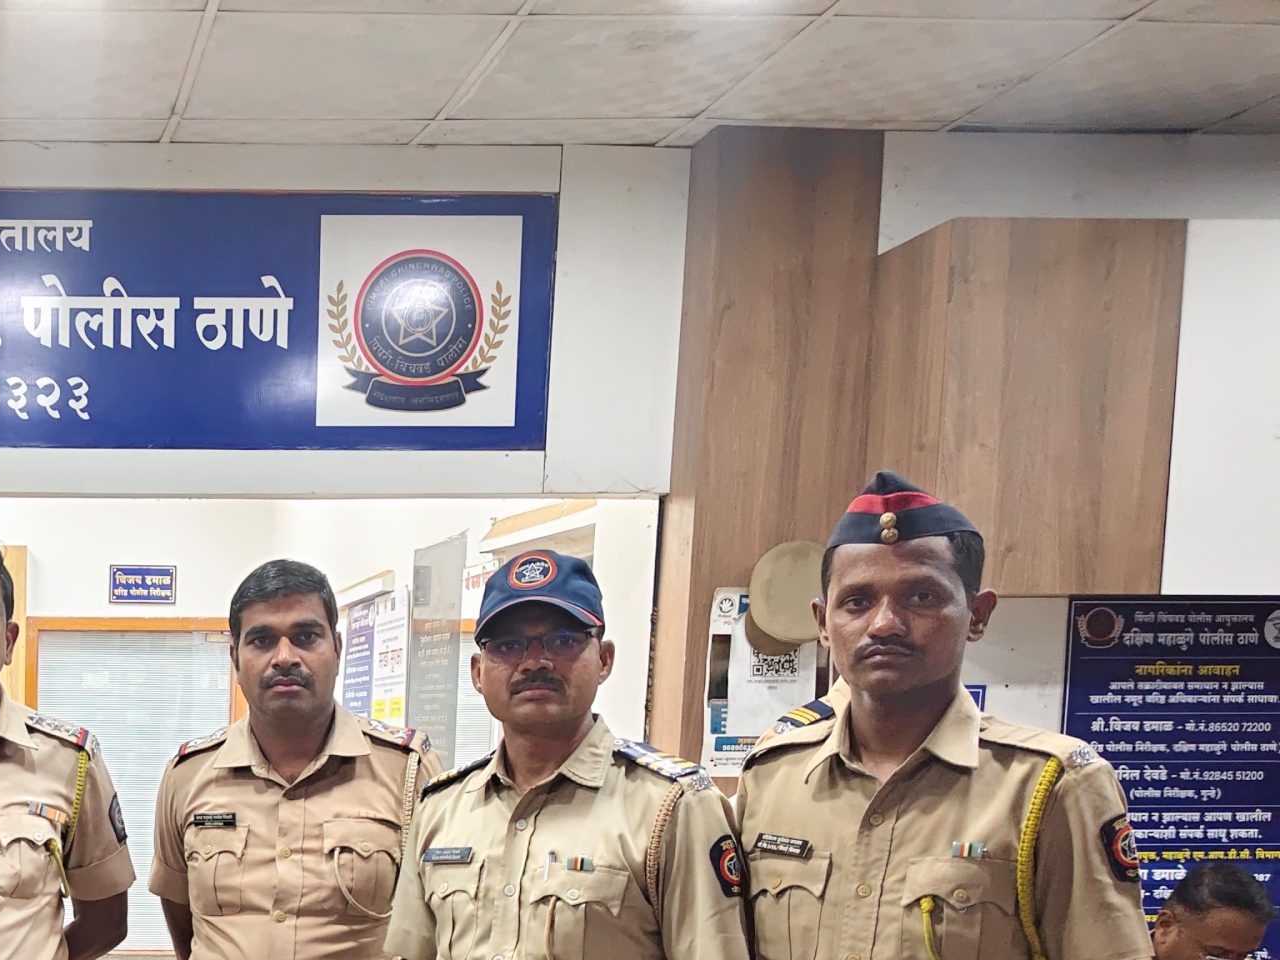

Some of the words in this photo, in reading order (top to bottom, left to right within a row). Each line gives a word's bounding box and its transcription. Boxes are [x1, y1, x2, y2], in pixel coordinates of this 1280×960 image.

[21, 273, 181, 351] पोलीस
[193, 274, 294, 351] ठाणे
[1122, 627, 1154, 646] दक्षिण
[1156, 627, 1194, 651] महाळुंगे
[1199, 627, 1234, 645] पोलीस
[1237, 627, 1260, 645] ठाणे
[1134, 660, 1193, 676] नागरिकांना
[1198, 665, 1241, 677] आवाहन
[1221, 681, 1228, 690] न
[1089, 692, 1122, 704] खालील
[1241, 722, 1271, 732] 72200
[1105, 741, 1134, 752] पोलीस
[1230, 740, 1258, 752] पोलीस
[1143, 765, 1168, 782] देवडे
[1235, 770, 1264, 780] 51200
[1151, 812, 1160, 822] न
[1161, 812, 1201, 824] झाल्यास
[1203, 811, 1233, 822] आपण
[1234, 808, 1272, 822] खालील
[1178, 825, 1205, 839] संपर्क
[1229, 828, 1263, 840] शकता.
